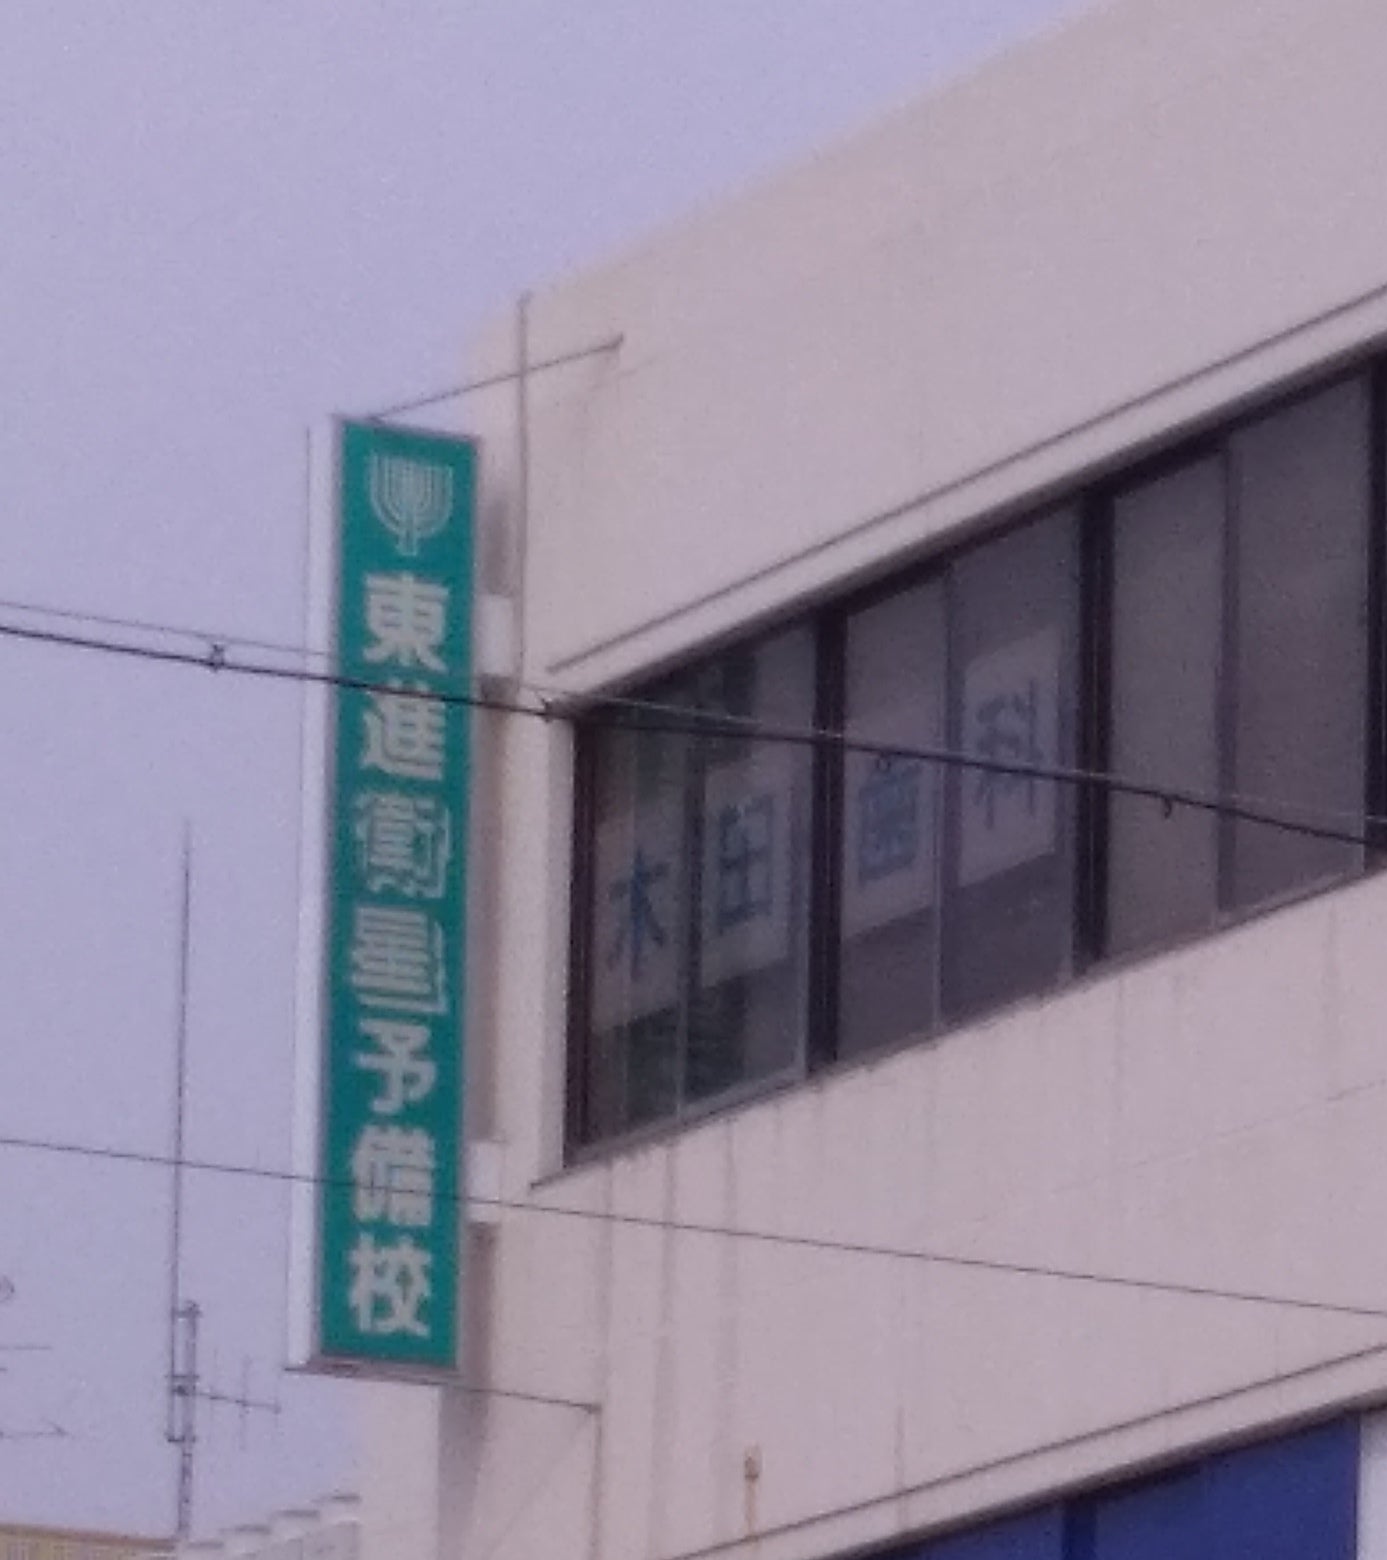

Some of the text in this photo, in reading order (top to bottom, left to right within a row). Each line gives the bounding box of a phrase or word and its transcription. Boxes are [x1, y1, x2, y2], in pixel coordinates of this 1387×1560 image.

[346, 570, 452, 1338] 東進衛星予備校
